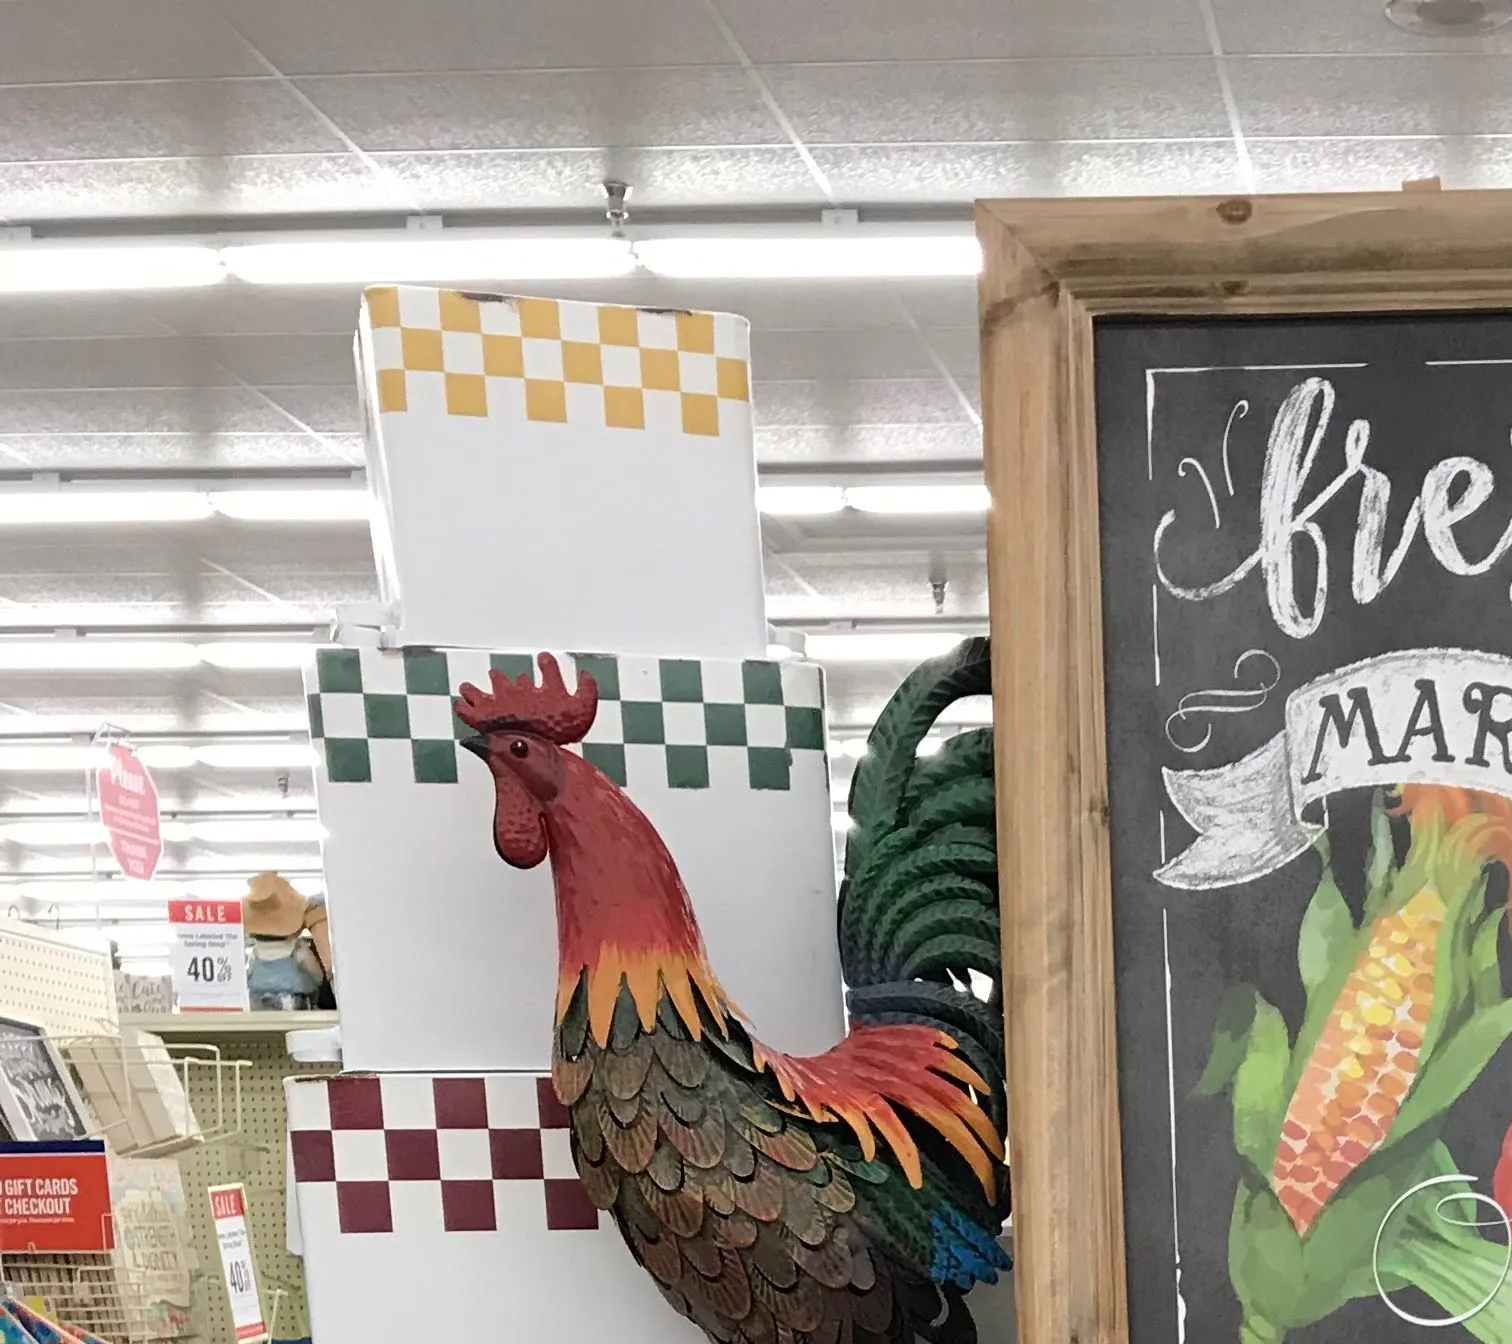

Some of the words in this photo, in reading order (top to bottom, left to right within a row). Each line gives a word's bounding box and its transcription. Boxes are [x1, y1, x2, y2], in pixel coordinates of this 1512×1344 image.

[184, 904, 226, 921] SALE
[5, 1179, 32, 1195] GIFT
[35, 1178, 79, 1195] CARDS
[4, 1198, 71, 1215] CHECKOUT
